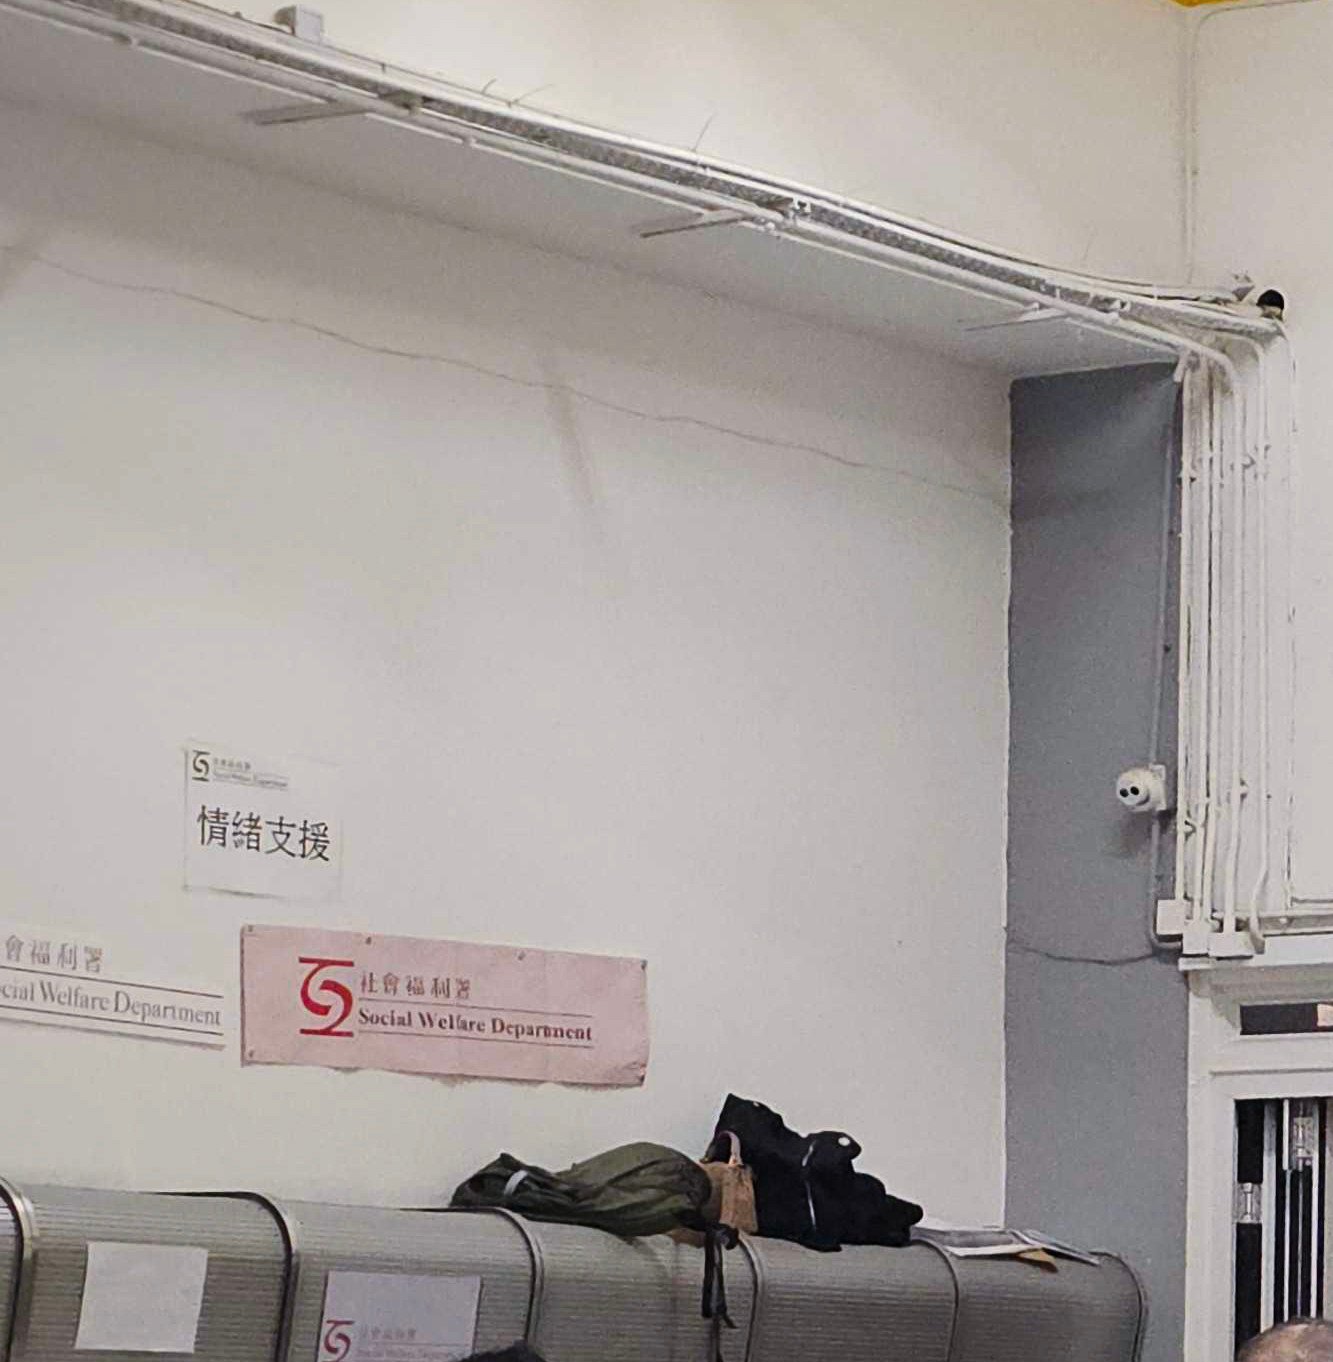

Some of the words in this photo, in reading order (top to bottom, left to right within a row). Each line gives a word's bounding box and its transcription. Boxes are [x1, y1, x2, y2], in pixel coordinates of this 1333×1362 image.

[196, 805, 331, 863] 情緒支援
[0, 979, 36, 1001] cial
[40, 979, 111, 1012] Welfare
[113, 990, 221, 1026] Department
[360, 971, 471, 999] 社會福利署
[358, 1007, 412, 1028] Social
[417, 1010, 487, 1034] Welfare
[491, 1017, 592, 1043] Department
